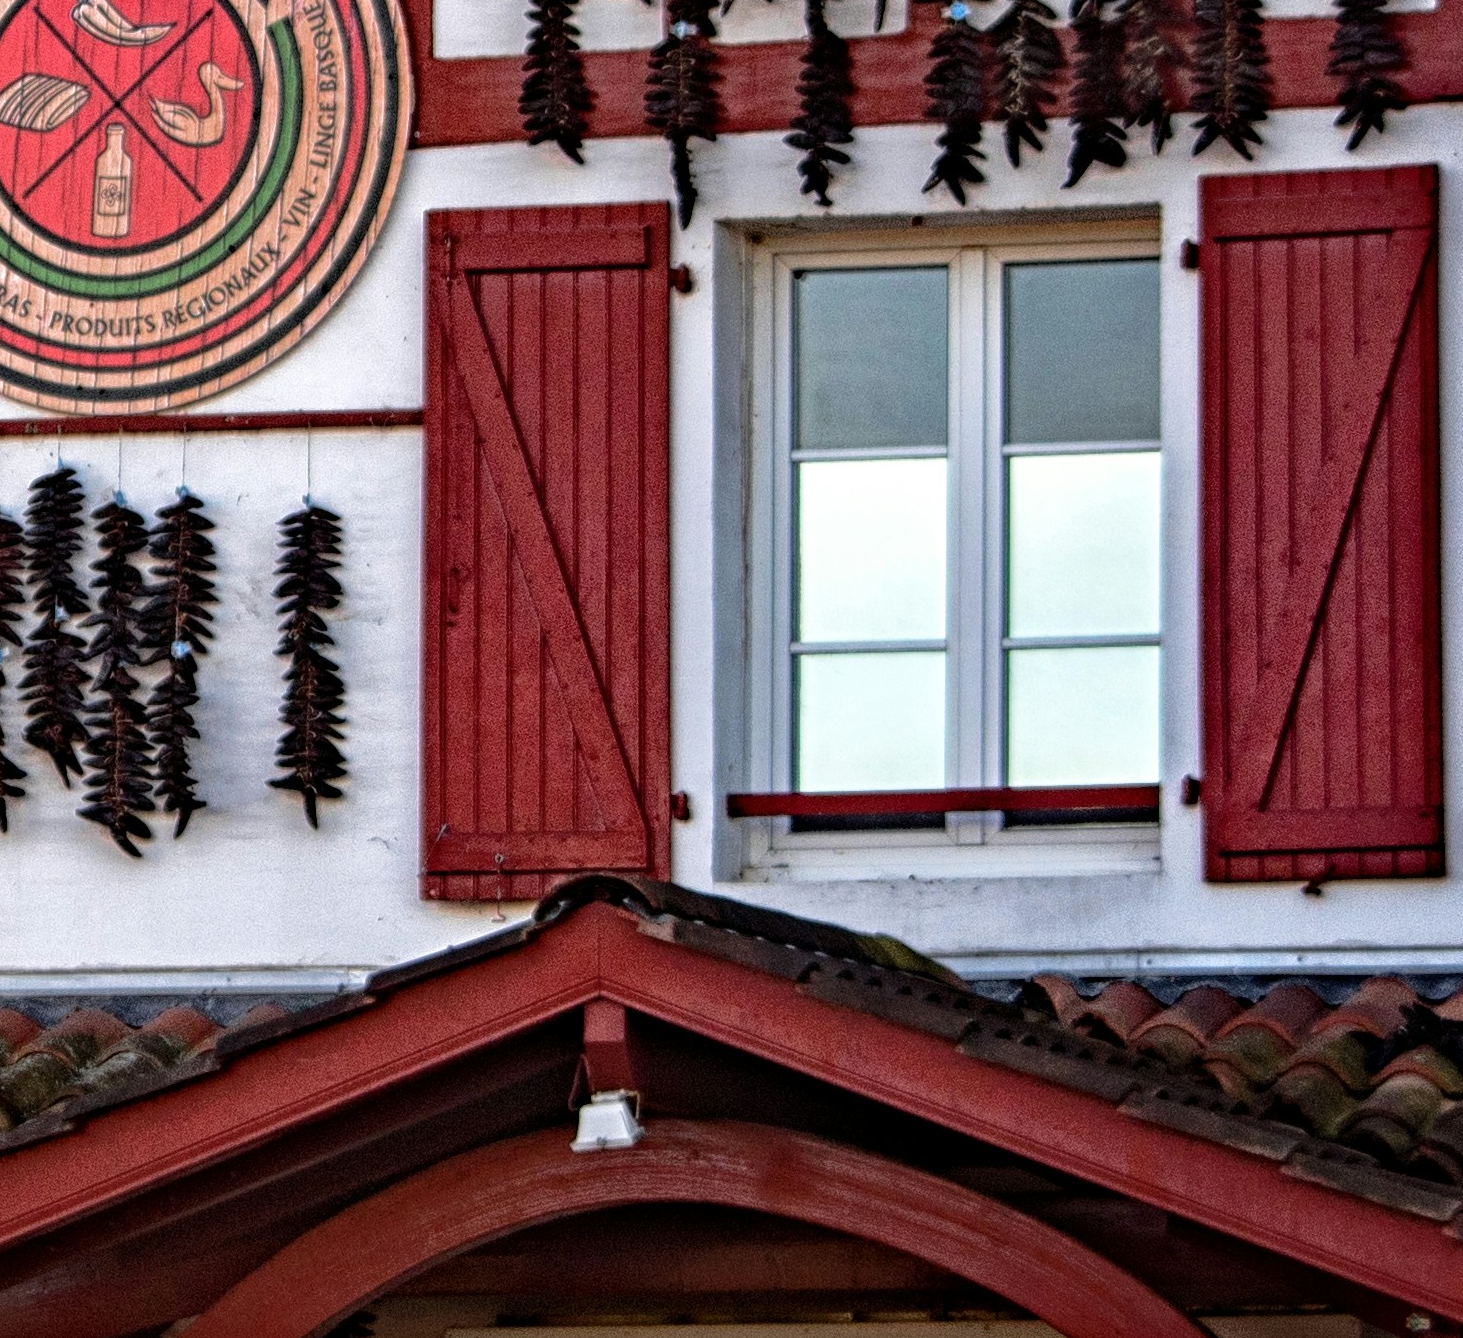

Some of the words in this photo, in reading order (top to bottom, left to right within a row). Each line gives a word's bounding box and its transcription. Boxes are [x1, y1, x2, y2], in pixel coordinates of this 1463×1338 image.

[48, 310, 157, 338] PRODUITS
[281, 187, 316, 233] VIN
[309, 98, 336, 170] LINGE
